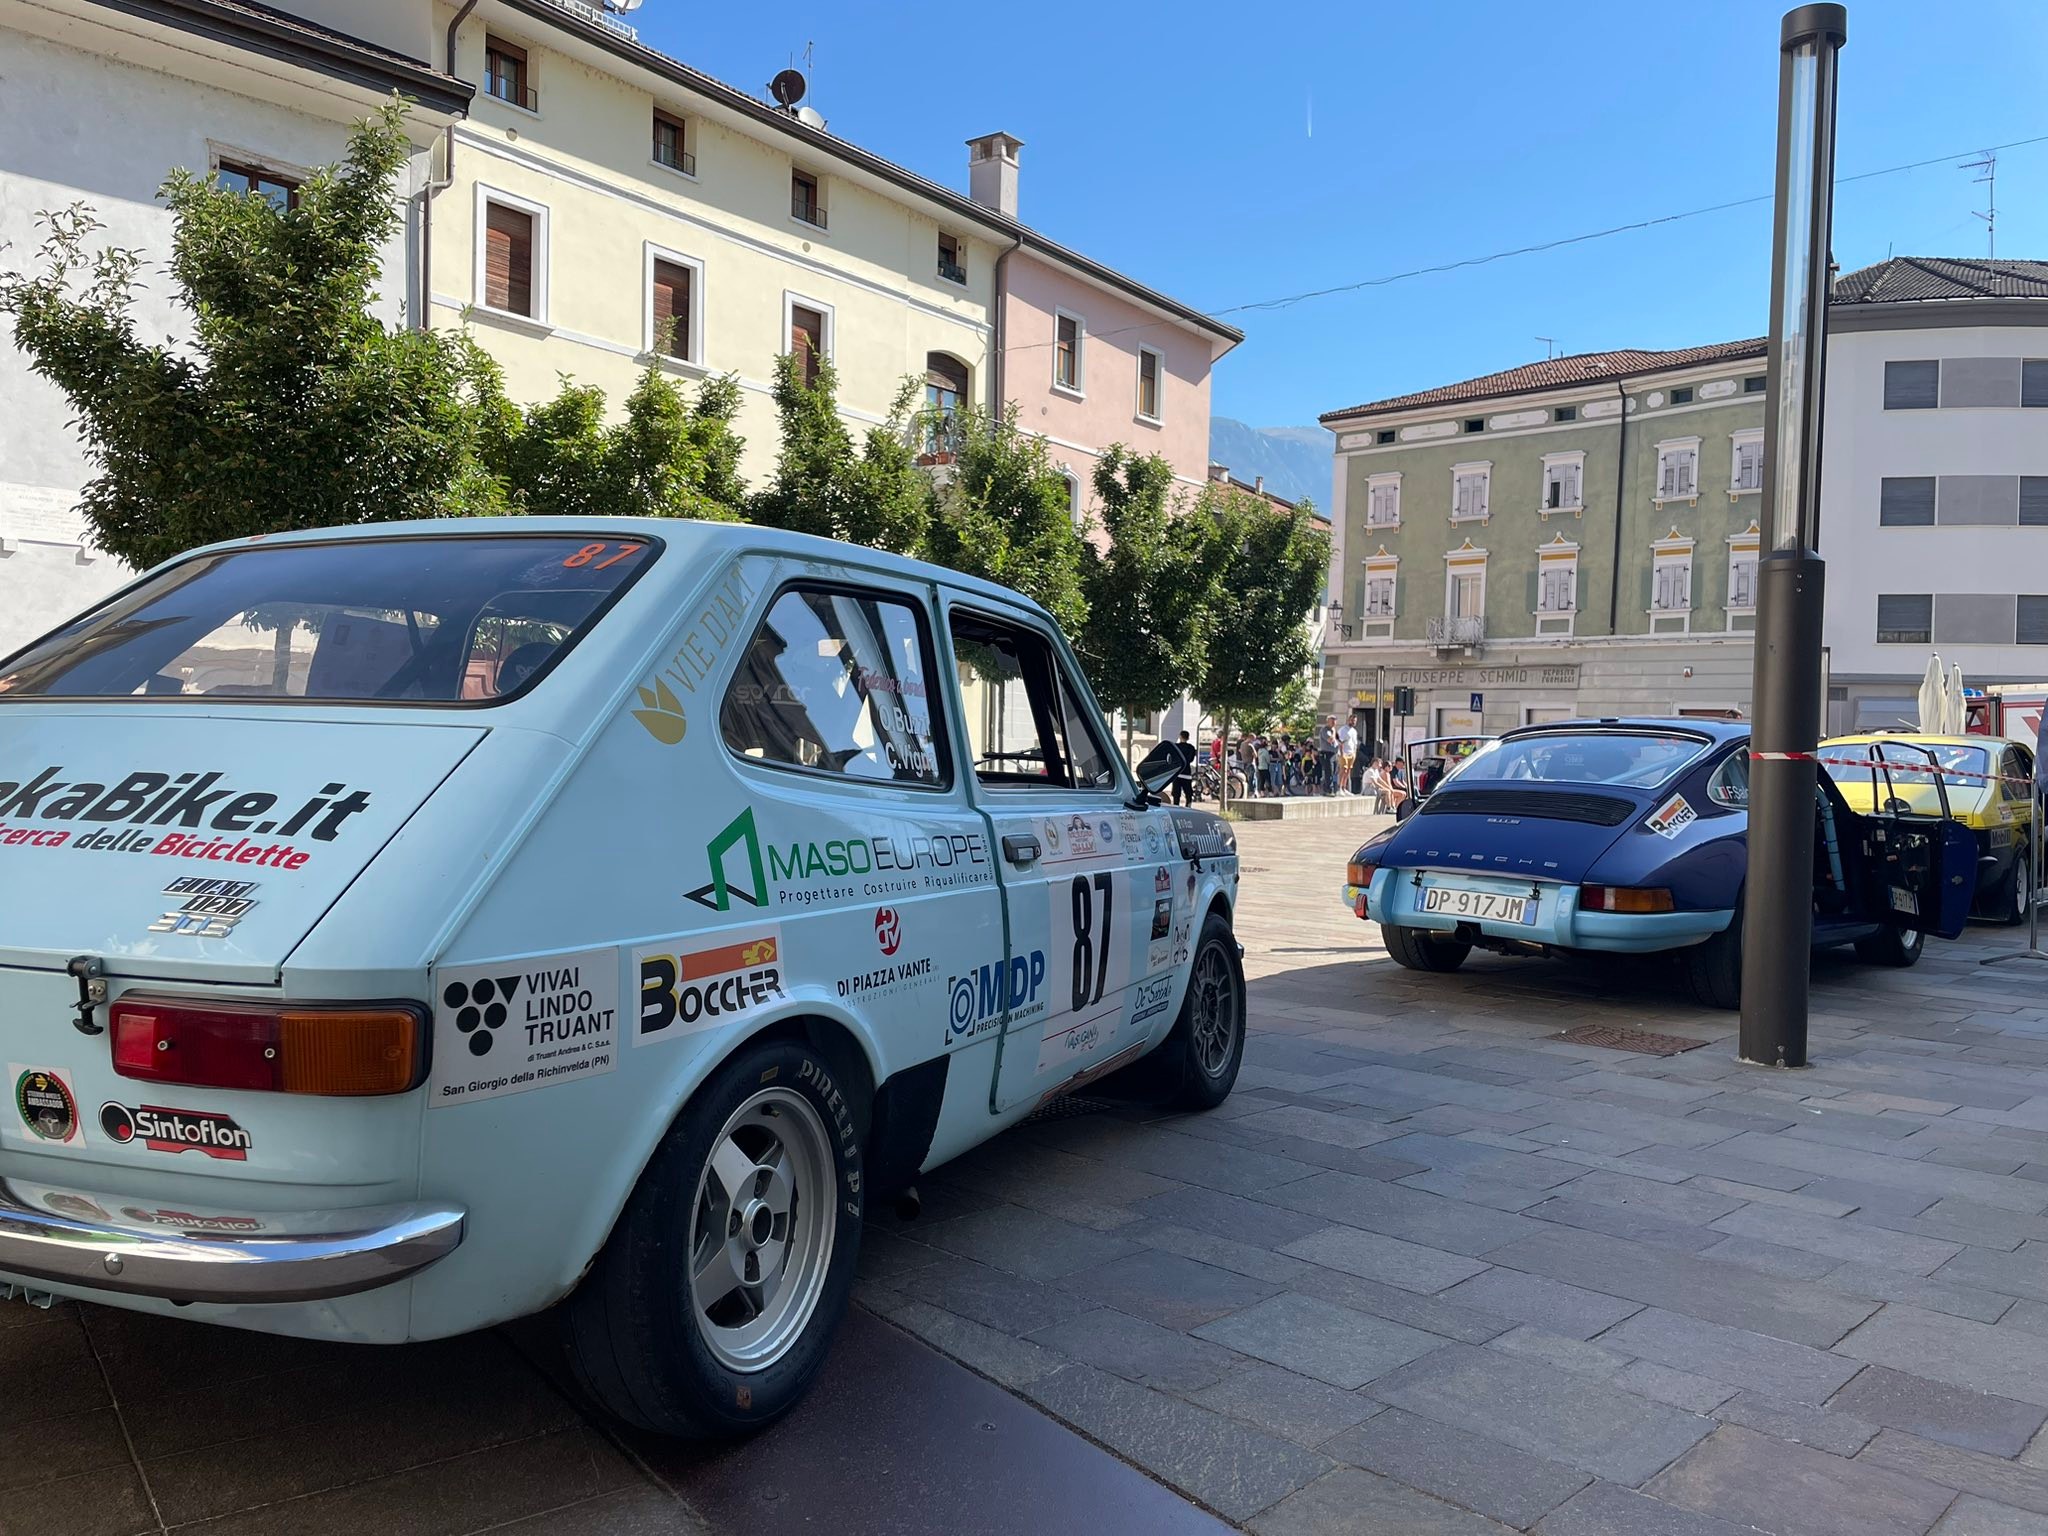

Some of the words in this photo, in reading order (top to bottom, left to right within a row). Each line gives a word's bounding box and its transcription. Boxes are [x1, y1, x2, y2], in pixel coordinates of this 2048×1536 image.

[563, 543, 641, 570] 87
[665, 632, 716, 693] VIE
[1401, 670, 1465, 684] GIUSEPPE
[1480, 670, 1527, 683] SCHMID
[72, 827, 154, 853] delle
[149, 833, 310, 870] Biciclette
[1405, 849, 1558, 868] PORSCHE
[168, 877, 251, 896] FIAT
[780, 887, 854, 905] Progettare
[863, 880, 917, 896] Costruire
[925, 872, 988, 888] Riqualificare
[187, 896, 248, 915] 127
[1072, 872, 1112, 1012] 87
[526, 967, 579, 995] VIVAI
[837, 978, 850, 997] DI
[853, 967, 895, 993] PIAZZA
[897, 958, 931, 980] VANTE
[978, 950, 1045, 1020] MDP
[526, 990, 592, 1021] LINDO
[641, 955, 786, 1034] BOCCHER
[525, 1009, 614, 1045] TRUANT
[1014, 1002, 1044, 1021] MACHINING
[527, 1054, 535, 1063] di
[536, 1050, 557, 1061] Truant
[443, 1085, 465, 1096] San
[468, 1078, 508, 1092] Giorgio
[510, 1073, 534, 1085] della
[537, 1059, 590, 1078] Richinvelda
[591, 1054, 610, 1069] (PN)
[136, 1111, 252, 1148] Sintoflon
